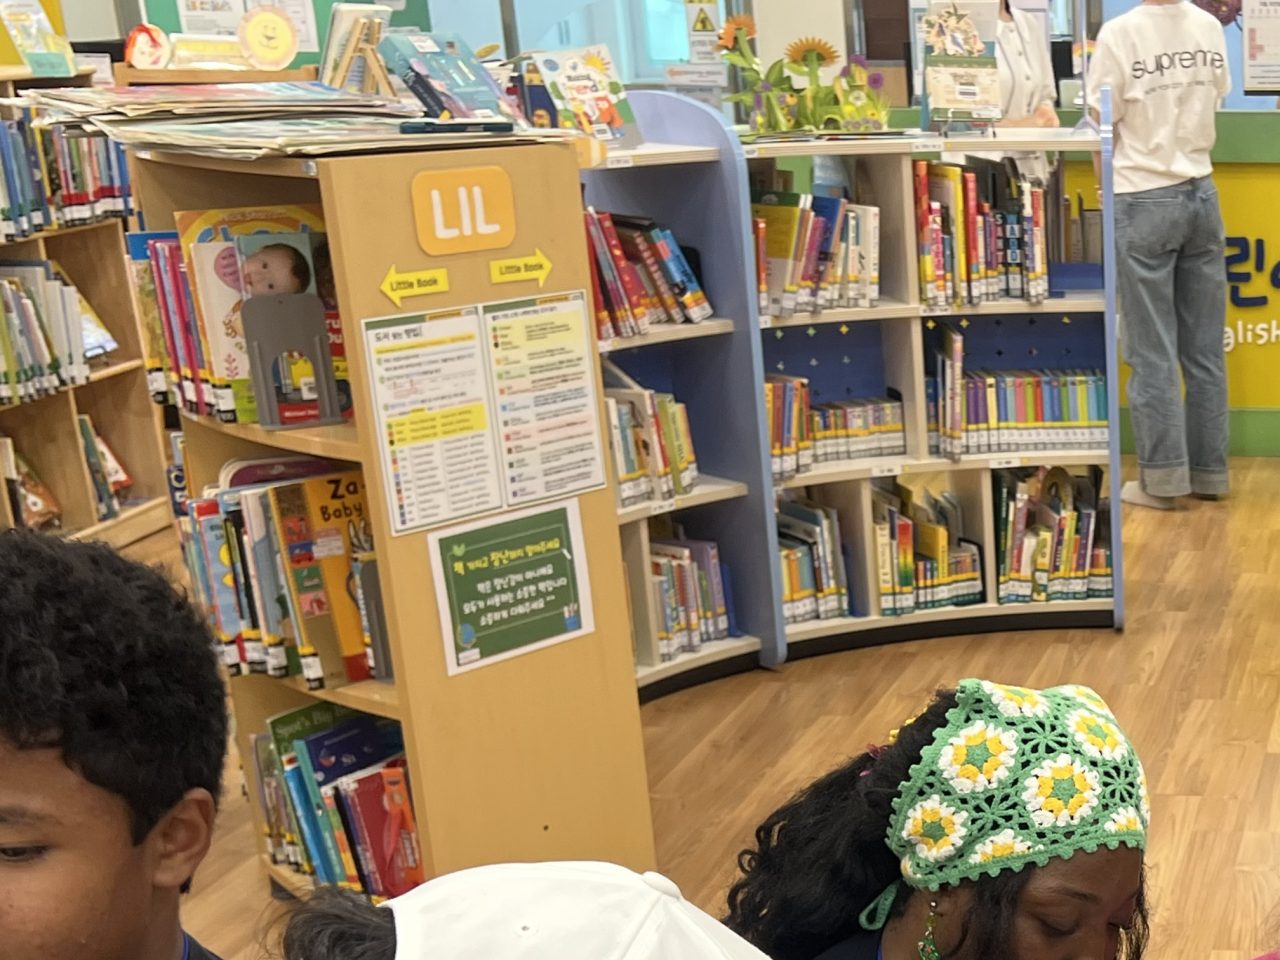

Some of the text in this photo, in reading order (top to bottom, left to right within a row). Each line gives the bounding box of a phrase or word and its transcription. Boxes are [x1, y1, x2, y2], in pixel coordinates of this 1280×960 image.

[1132, 49, 1224, 79] supreme
[431, 185, 501, 239] LIL
[499, 261, 545, 276] Little Book
[390, 276, 439, 292] Little Book
[320, 501, 363, 522] Baby
